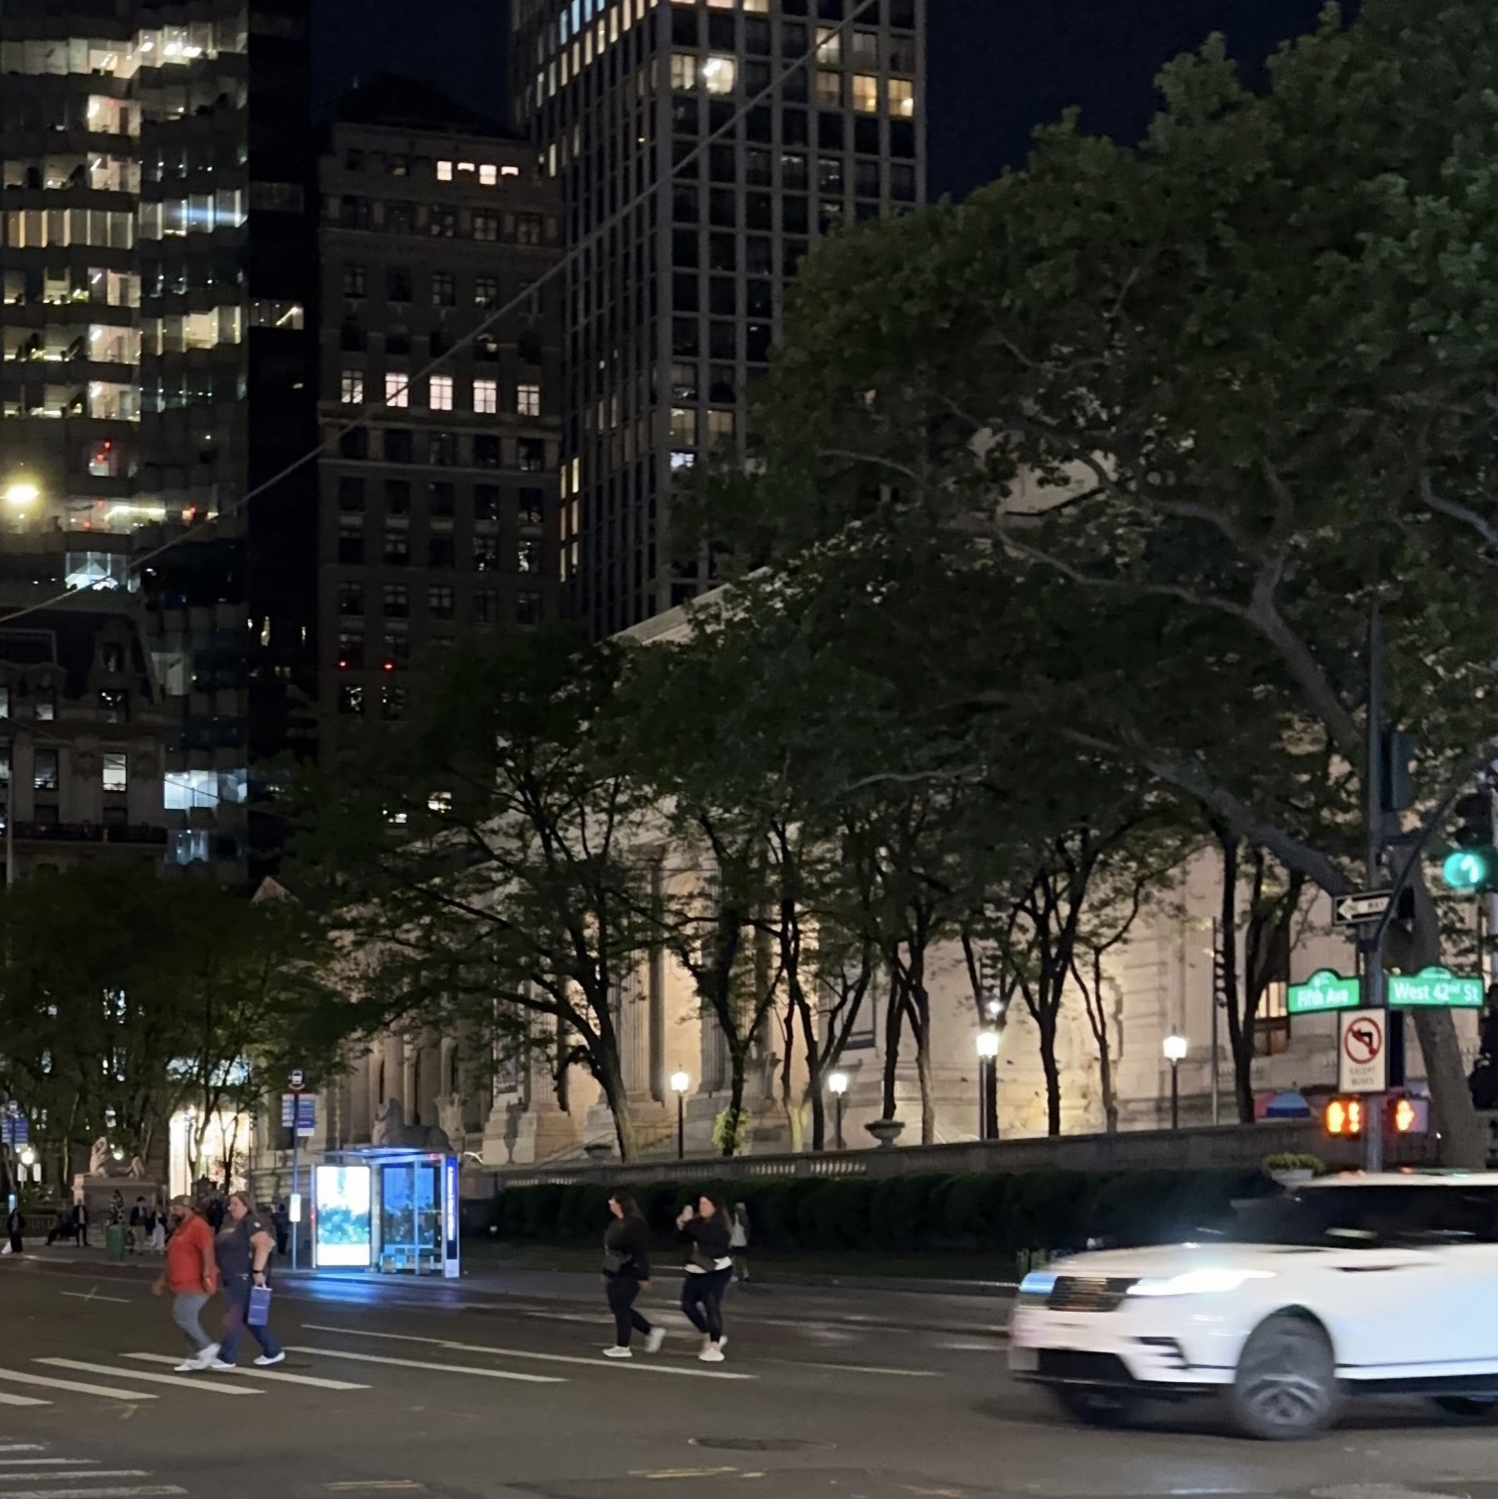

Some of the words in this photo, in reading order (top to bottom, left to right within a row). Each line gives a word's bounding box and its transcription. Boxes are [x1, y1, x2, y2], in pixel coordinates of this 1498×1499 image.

[1297, 988, 1324, 1007] Fifth
[1326, 987, 1349, 1005] Ave
[1393, 981, 1430, 1000] West
[1463, 982, 1480, 1002] St
